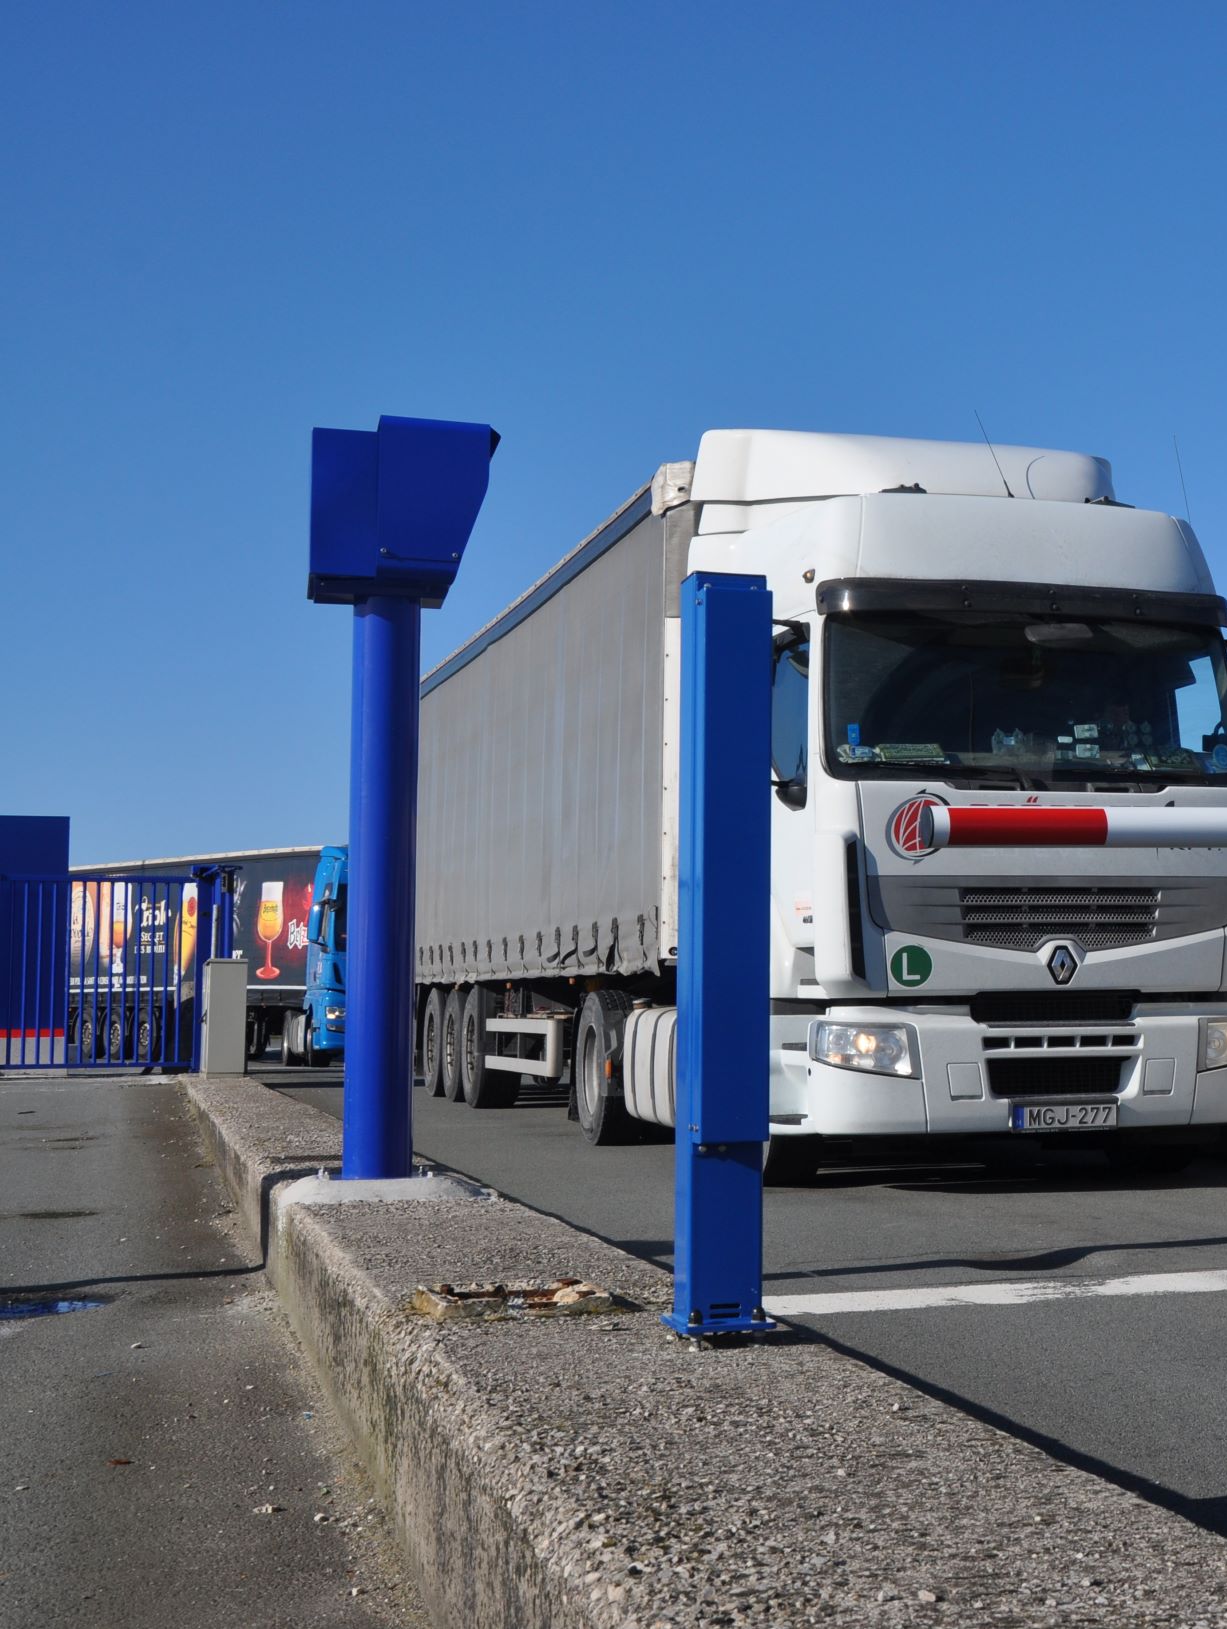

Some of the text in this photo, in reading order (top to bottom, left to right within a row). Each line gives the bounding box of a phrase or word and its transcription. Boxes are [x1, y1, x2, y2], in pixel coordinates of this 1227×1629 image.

[140, 931, 164, 941] SECET
[902, 953, 920, 980] L
[1028, 1106, 1112, 1126] MGJ-277
